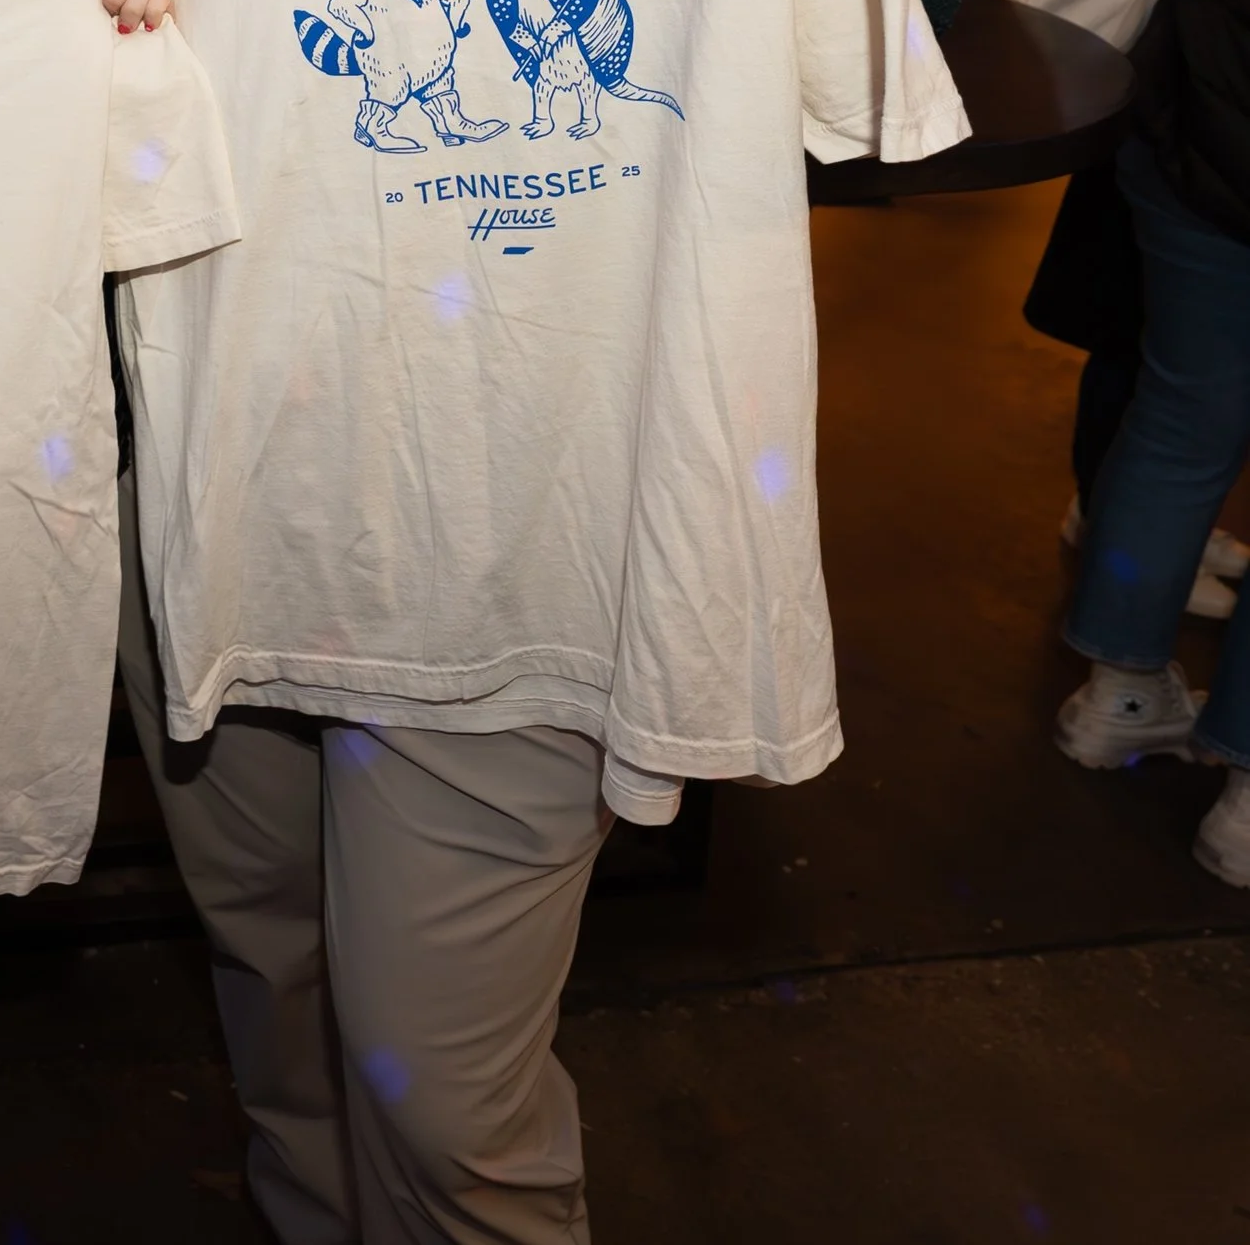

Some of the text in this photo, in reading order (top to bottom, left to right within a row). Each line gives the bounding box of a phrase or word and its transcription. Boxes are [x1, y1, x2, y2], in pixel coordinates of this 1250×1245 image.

[385, 163, 641, 204] 20 TENNESSEE 25
